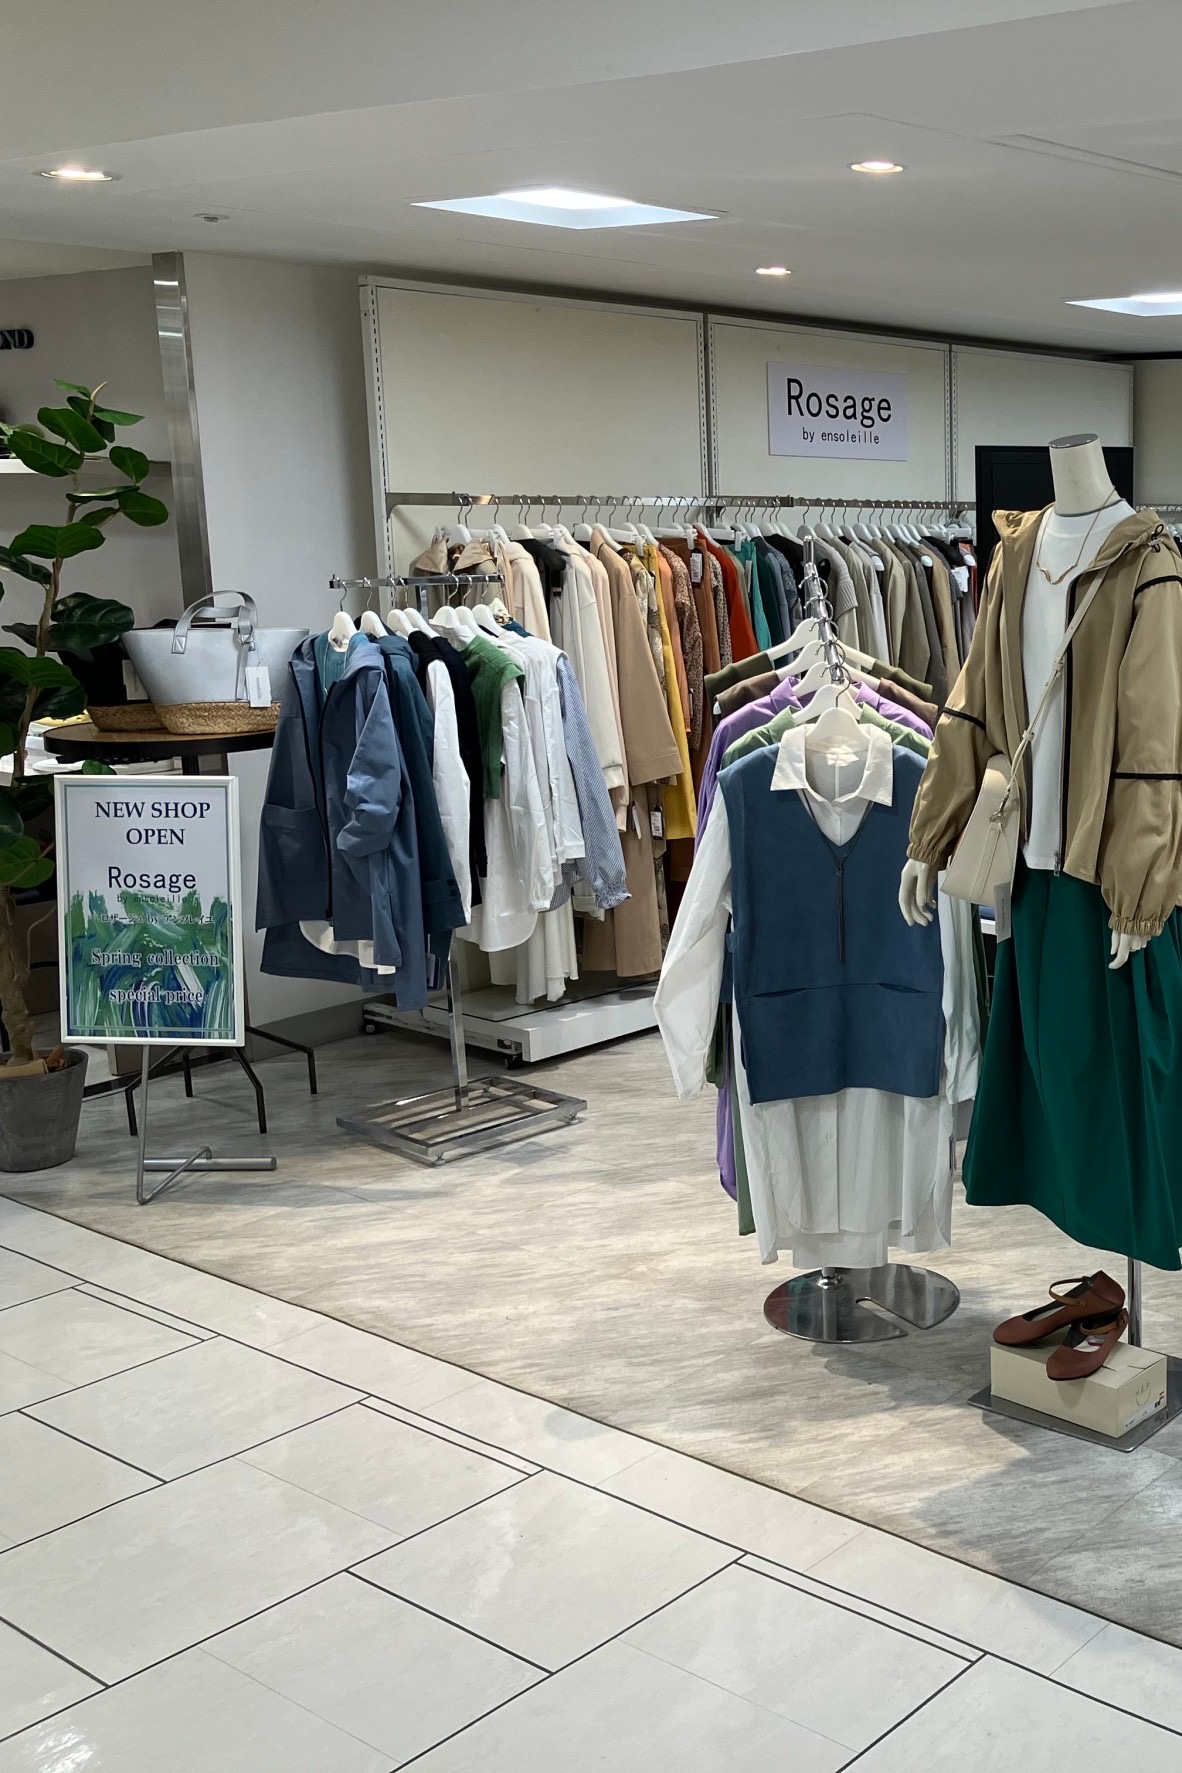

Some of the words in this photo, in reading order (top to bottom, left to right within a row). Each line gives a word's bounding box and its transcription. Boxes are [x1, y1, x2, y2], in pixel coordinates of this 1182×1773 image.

[786, 377, 892, 429] Rosage
[802, 427, 815, 443] by
[821, 429, 880, 444] ensoleille
[95, 801, 145, 818] NEW
[151, 801, 211, 818] SHOP
[126, 828, 185, 845] OPEN
[108, 866, 197, 893] Rosage
[117, 894, 128, 904] by
[147, 914, 159, 925] by
[91, 948, 142, 967] Spring
[147, 949, 220, 967] collection
[109, 986, 160, 1002] special
[165, 987, 204, 1004] price
